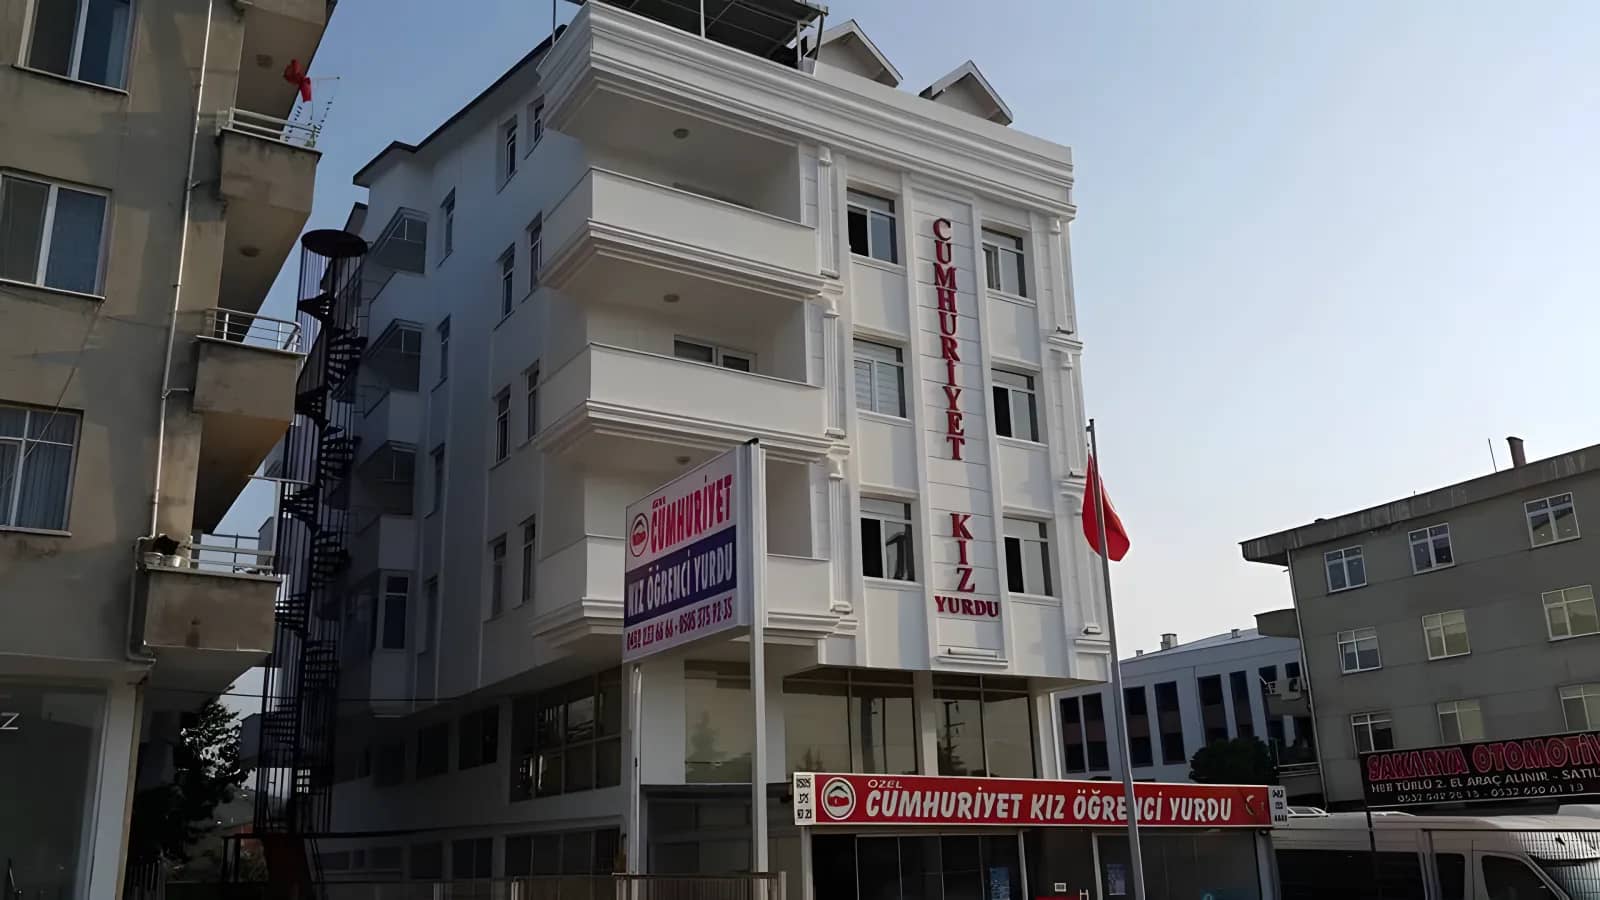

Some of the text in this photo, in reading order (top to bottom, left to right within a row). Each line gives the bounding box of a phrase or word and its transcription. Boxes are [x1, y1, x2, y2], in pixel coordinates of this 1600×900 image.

[650, 474, 733, 553] CUMHURİYET
[628, 579, 645, 618] KIZ
[694, 542, 733, 593] YURDU
[950, 513, 975, 593] KIZ
[934, 595, 999, 617] YURDU
[866, 786, 1023, 820] CUMHURİYET
[1030, 794, 1066, 821] KIZ
[1169, 797, 1233, 822] YURDU
[1505, 770, 1550, 784] ALINIR
